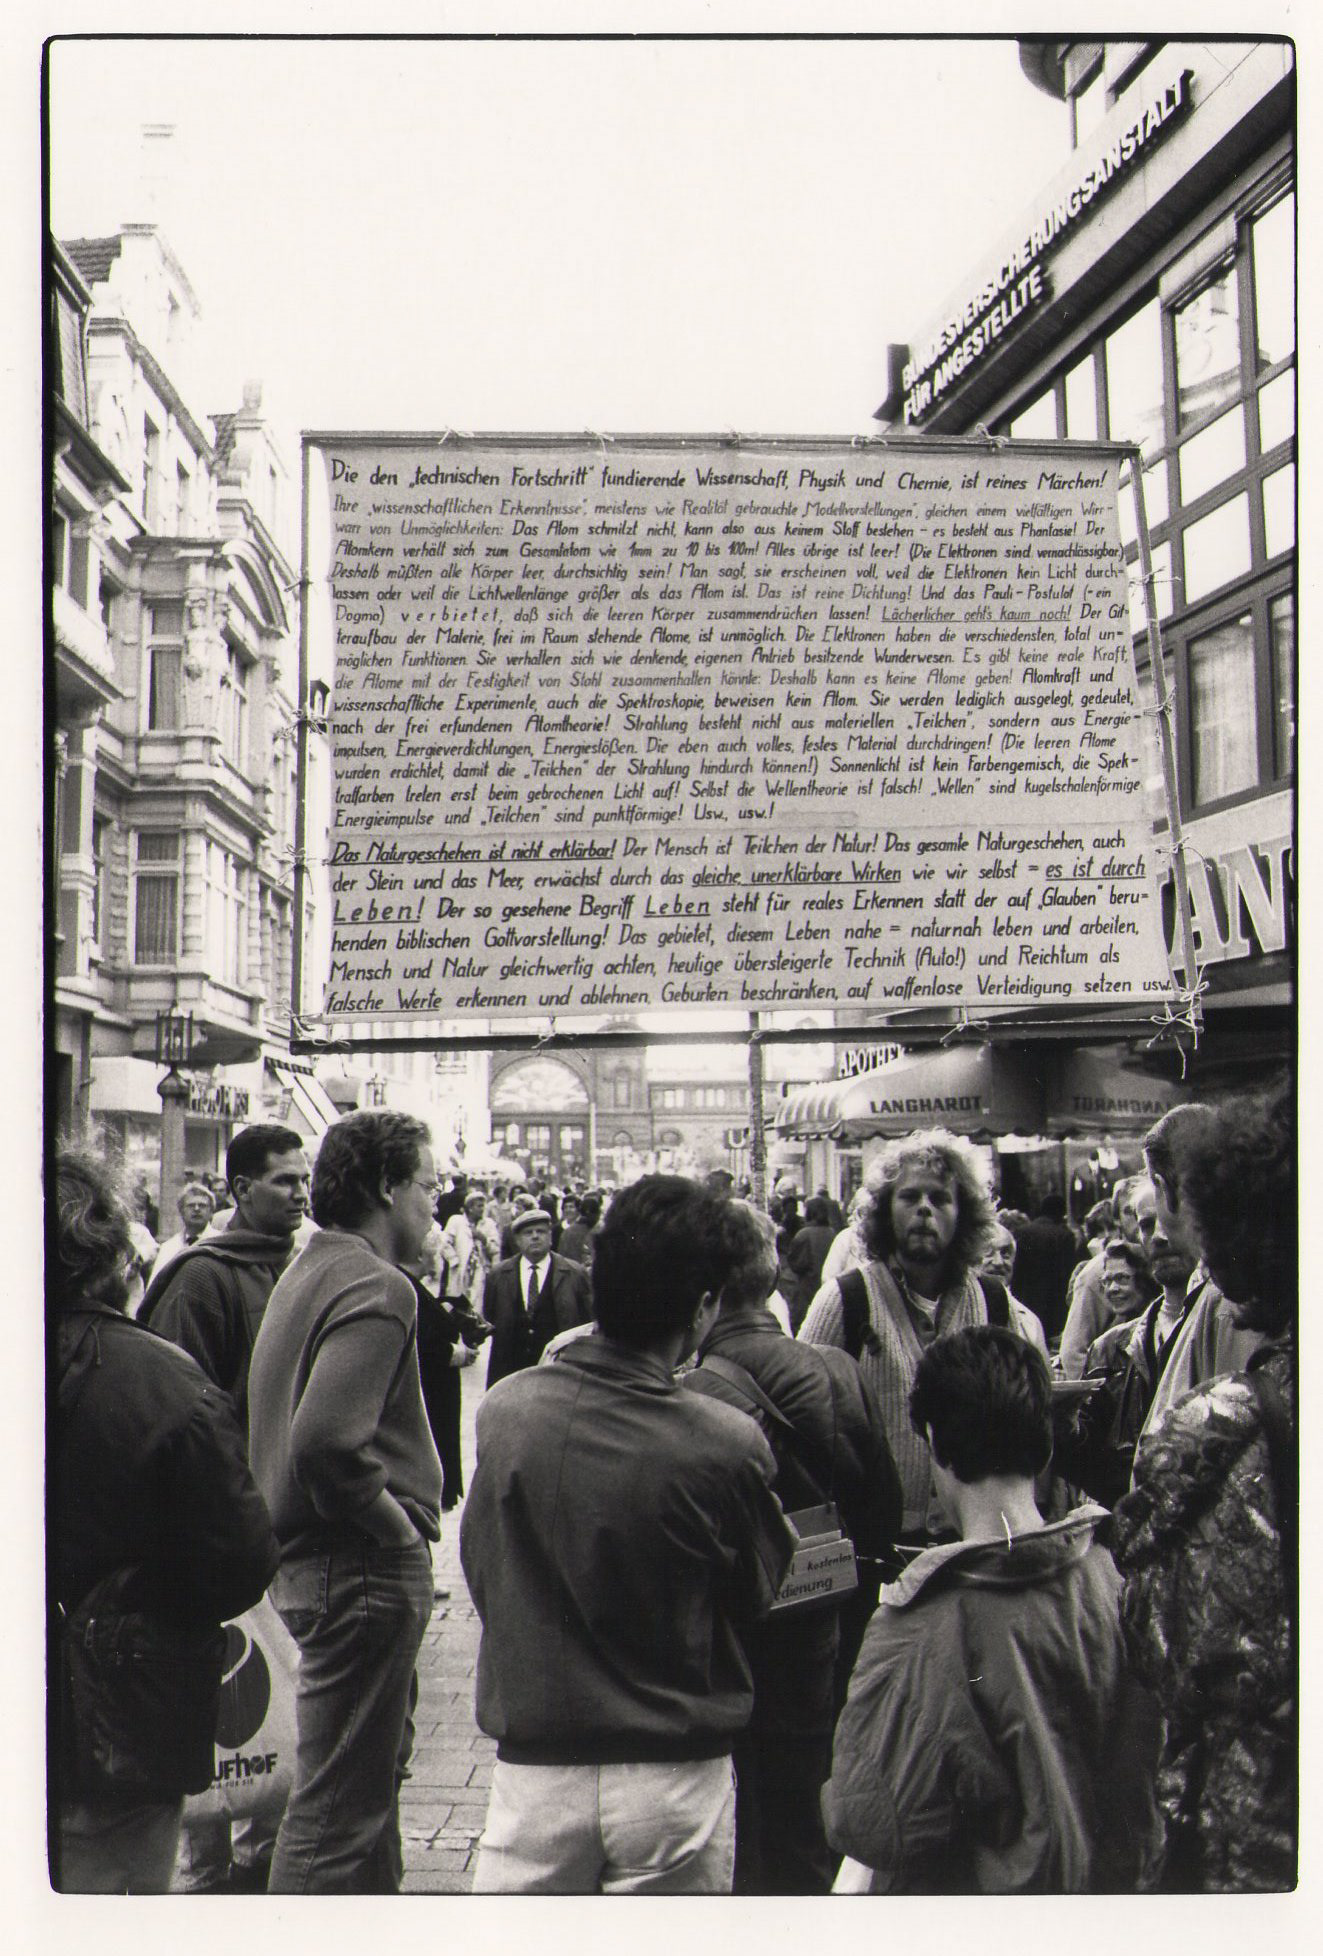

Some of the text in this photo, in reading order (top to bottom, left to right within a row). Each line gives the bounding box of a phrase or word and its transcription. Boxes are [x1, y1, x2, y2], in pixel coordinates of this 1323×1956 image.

[902, 70, 1191, 392] BUNDESVERSICHERUNGSANSTALT
[903, 266, 1044, 425] FÜR ANGESTELLTE
[331, 464, 359, 483] Die
[370, 465, 398, 485] den
[602, 466, 686, 488] fundierende
[798, 469, 846, 492] Physik
[856, 471, 885, 488] und
[961, 471, 980, 489] ist
[986, 474, 1028, 490] reines
[336, 628, 397, 647] teraufbau
[406, 629, 426, 644] der
[493, 628, 514, 647] frei
[520, 630, 535, 644] im
[542, 627, 578, 644] Raum
[587, 627, 642, 643] stehende
[698, 627, 713, 642] ist
[795, 625, 815, 642] Die
[822, 625, 885, 642] Elektronen
[895, 626, 931, 642] haben
[939, 627, 956, 642] die
[1064, 625, 1091, 641] total
[334, 694, 444, 714] wissenschaftliche
[547, 693, 579, 709] auch
[588, 692, 608, 709] die
[714, 692, 774, 708] beweisen
[786, 691, 812, 707] kein
[870, 690, 890, 706] Sie
[899, 690, 944, 706] werden
[955, 690, 1005, 710] lediglich
[333, 808, 434, 830] Energieimpulse
[444, 807, 472, 825] und
[554, 805, 585, 822] sind
[331, 841, 361, 867] Das
[365, 841, 481, 865] Naturgeschehen
[487, 840, 507, 863] ist
[510, 840, 543, 862] nicht
[622, 837, 648, 857] Der
[655, 836, 708, 856] Mensch
[716, 836, 733, 855] ist
[744, 834, 798, 855] Teilchen
[805, 834, 827, 853] der
[884, 831, 911, 852] Das
[916, 832, 969, 856] gesamte
[1092, 829, 1126, 849] auch
[332, 871, 358, 893] der
[366, 870, 404, 891] Stein
[413, 869, 445, 890] und
[451, 869, 478, 889] das
[534, 866, 602, 887] erwächst
[610, 866, 652, 886] durch
[660, 867, 684, 885] das
[749, 862, 842, 886] unerklärbare
[848, 860, 901, 884] Wirken
[912, 863, 935, 880] wie
[946, 863, 968, 880] wir
[978, 858, 1018, 879] selbst
[1045, 864, 1063, 881] es
[1071, 857, 1094, 881] ist
[1099, 856, 1146, 880] durch
[436, 898, 466, 919] Der
[472, 901, 493, 919] so
[501, 897, 572, 921] gesehene
[579, 895, 635, 920] Begriff
[722, 892, 760, 912] steht
[766, 892, 791, 916] für
[802, 891, 844, 911] reales
[853, 890, 924, 910] Erkennen
[934, 888, 966, 908] statt
[974, 888, 998, 908] der
[1007, 887, 1033, 911] auf
[331, 930, 387, 952] henden
[396, 928, 470, 950] biblischen
[618, 923, 648, 945] Das
[727, 922, 774, 943] diesem
[785, 920, 830, 941] Leben
[844, 919, 882, 939] nahe
[911, 916, 982, 937] naturnah
[992, 916, 1033, 937] leben
[1042, 915, 1072, 936] und
[329, 959, 392, 982] Mensch
[403, 959, 433, 979] und
[442, 957, 489, 978] Natur
[499, 955, 594, 980] gleichwertig
[668, 951, 723, 976] heutige
[734, 949, 833, 973] übersteigerte
[847, 947, 906, 969] Technik
[978, 946, 1008, 966] und
[1018, 944, 1088, 966] Reichtum
[1099, 943, 1120, 963] als
[326, 990, 384, 1015] falsche
[394, 988, 442, 1013] Werte
[456, 987, 527, 1008] erkennen
[538, 985, 573, 1006] und
[661, 981, 728, 1002] Geburten
[847, 977, 873, 1000] auf
[883, 975, 963, 999] waffenlose
[977, 974, 1072, 998] Verteidigung
[1084, 972, 1132, 993] setzen
[870, 1095, 983, 1114] LANGHARDT
[807, 1553, 852, 1571] kostenlos
